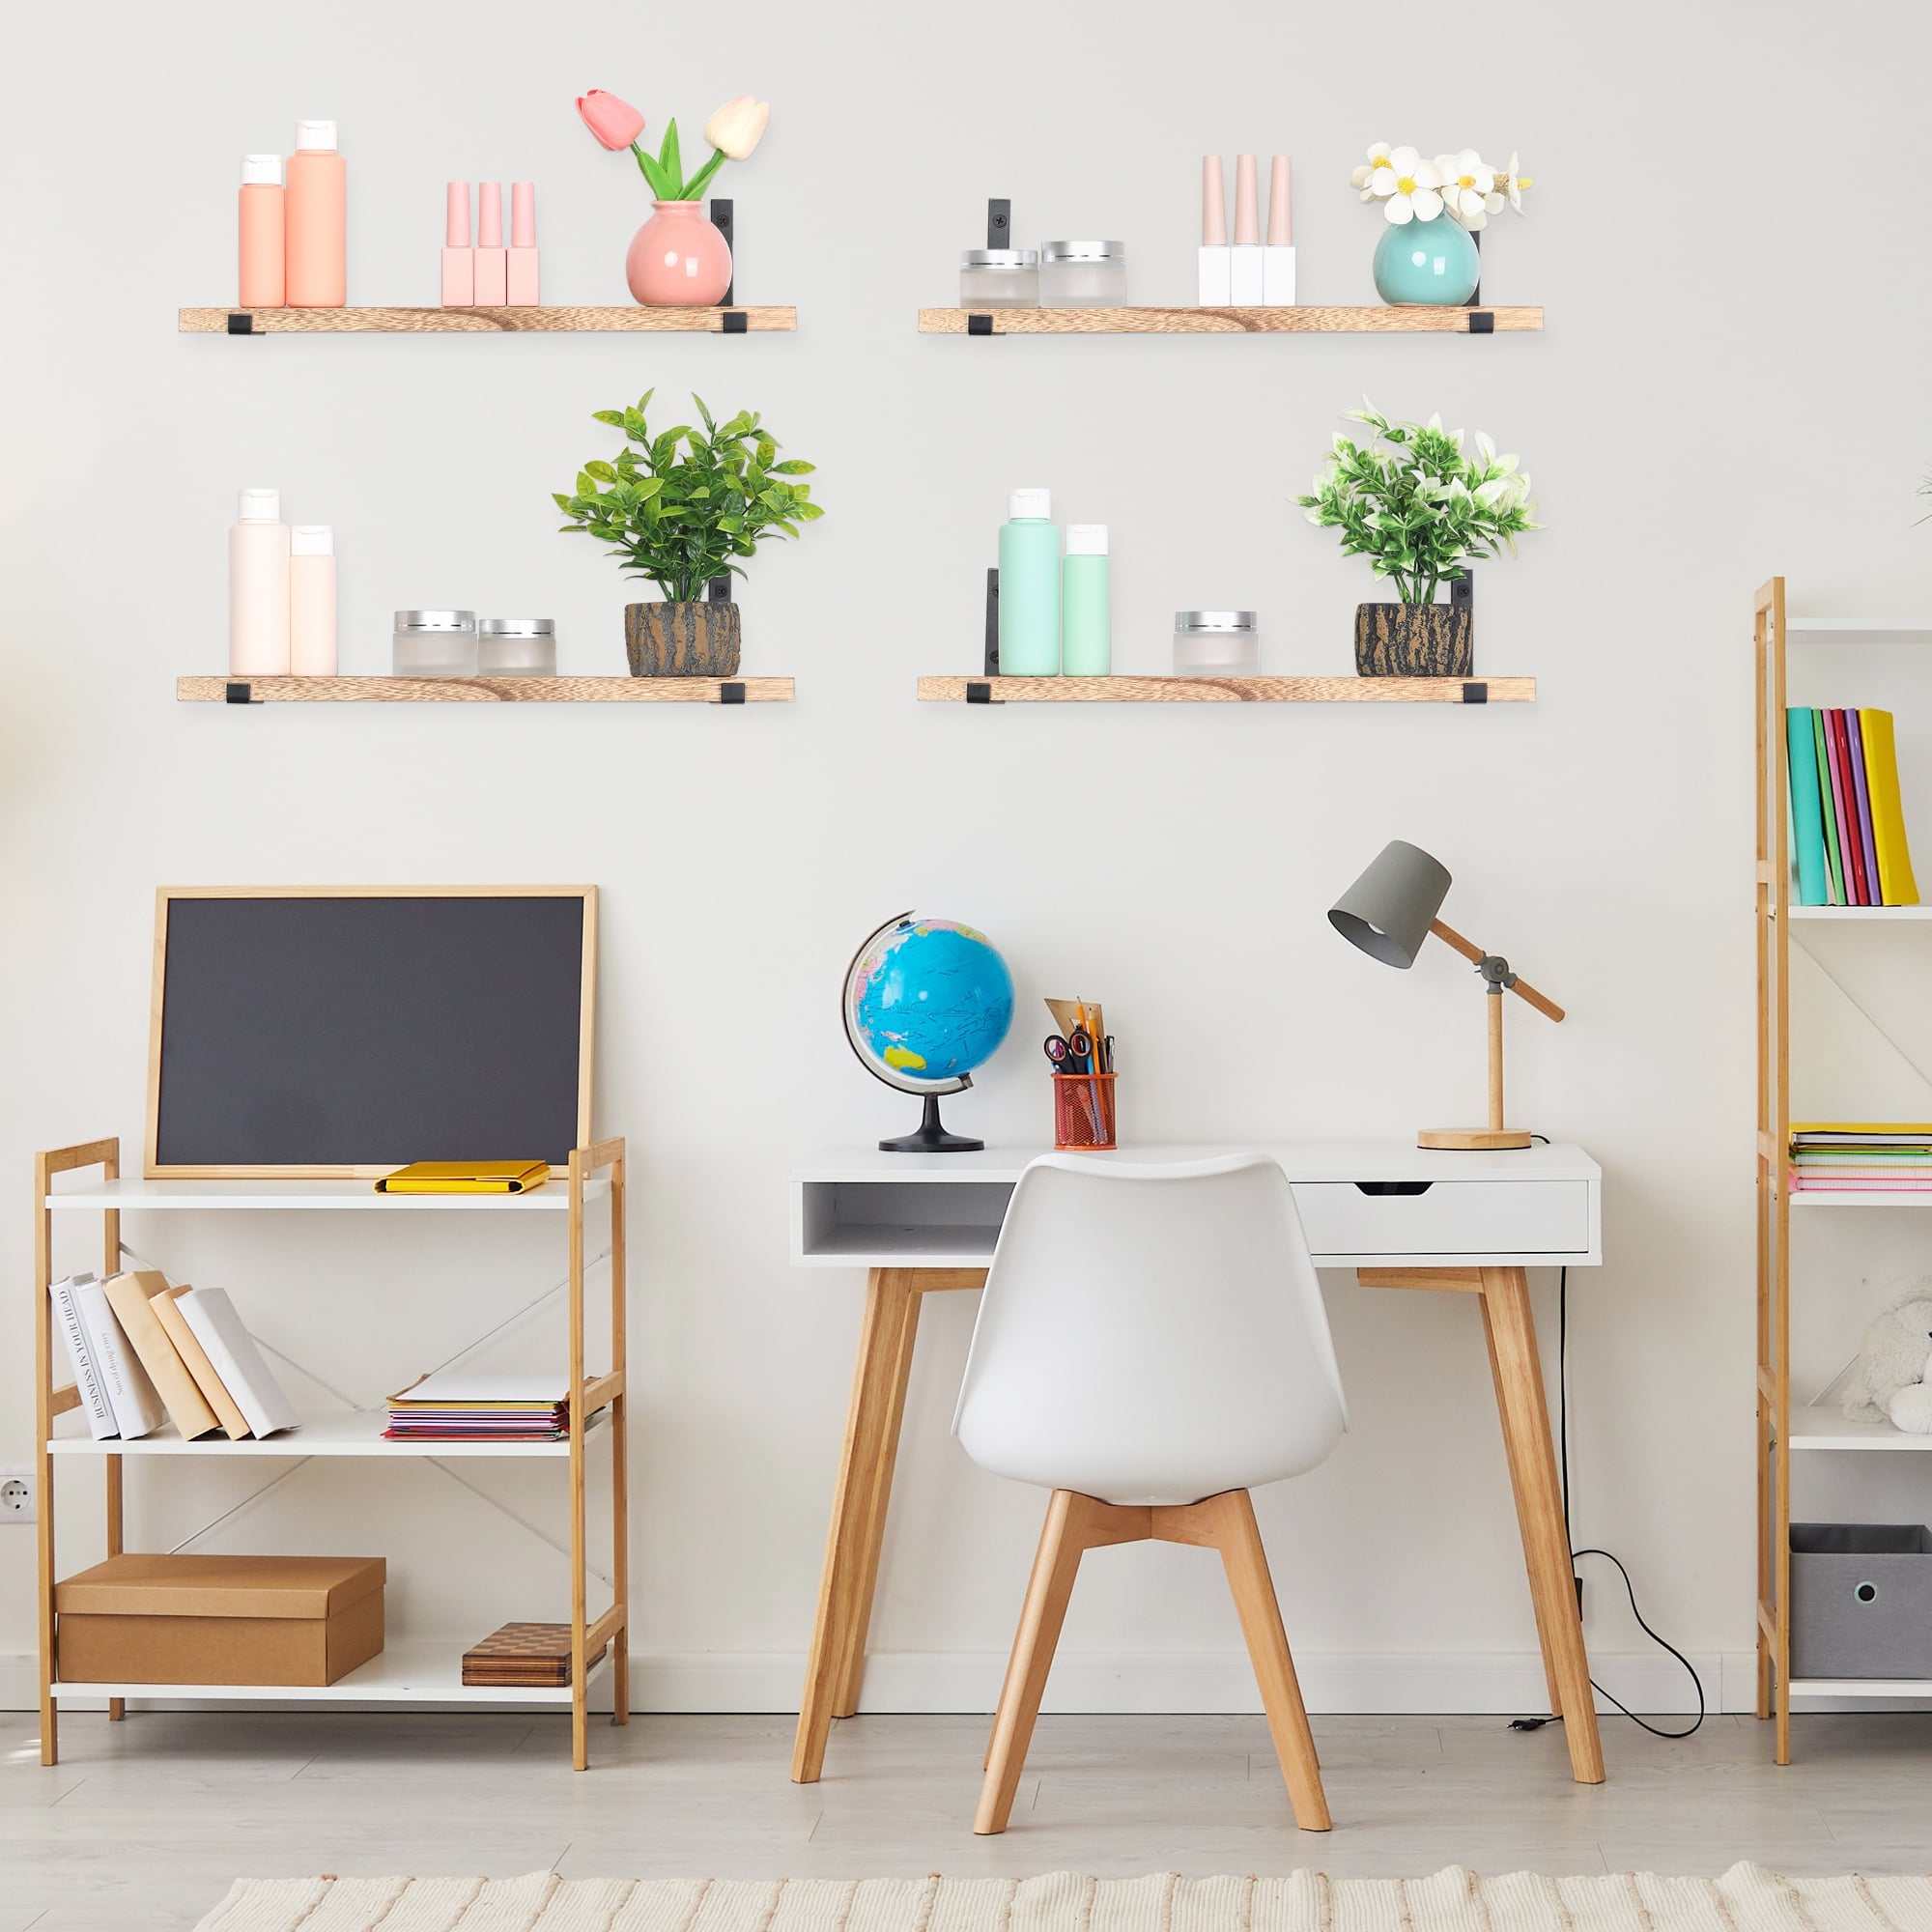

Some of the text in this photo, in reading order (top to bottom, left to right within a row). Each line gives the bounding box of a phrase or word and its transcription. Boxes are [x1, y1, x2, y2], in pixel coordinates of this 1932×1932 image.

[58, 1290, 104, 1419] BUSINESS IN YOUR HEAD
